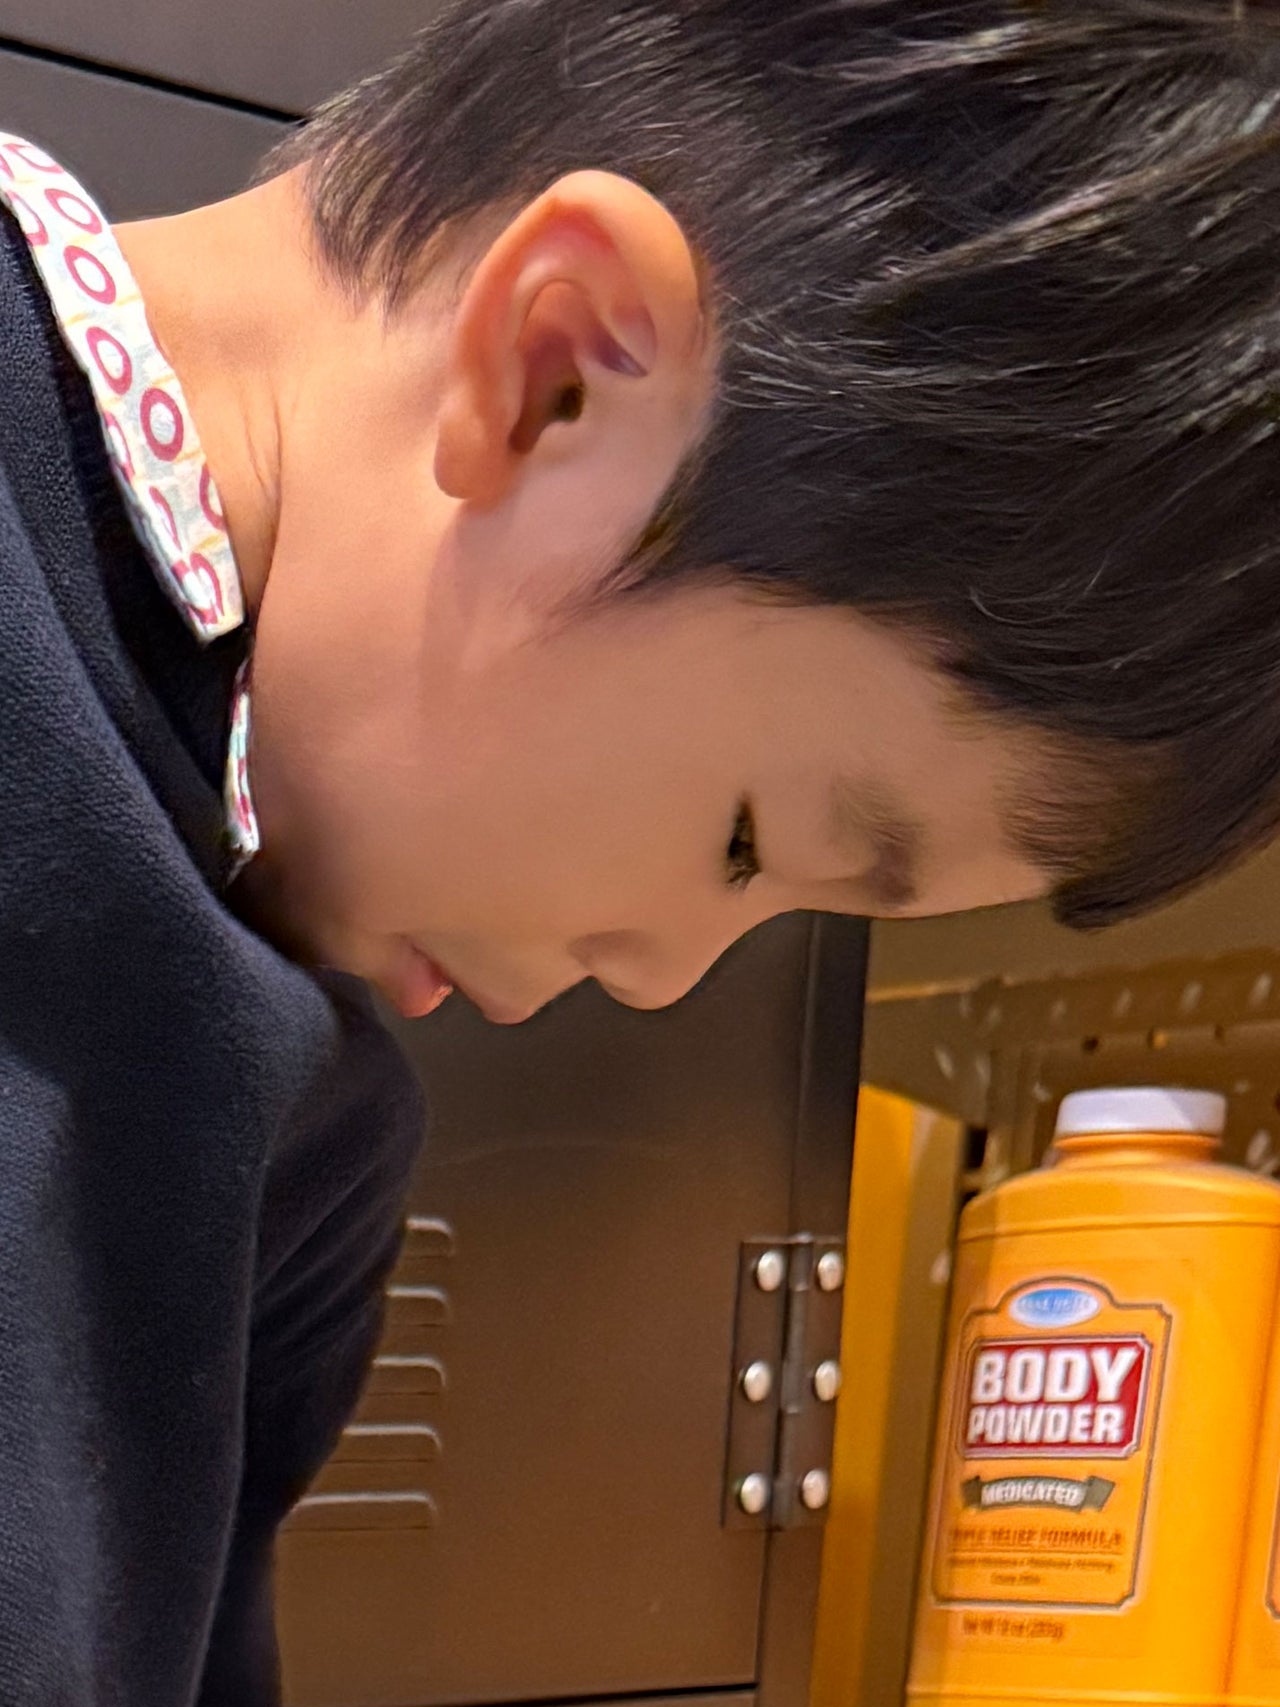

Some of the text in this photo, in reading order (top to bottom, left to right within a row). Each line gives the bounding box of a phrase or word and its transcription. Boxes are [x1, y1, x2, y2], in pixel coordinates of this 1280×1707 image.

[971, 1346, 1140, 1404] BODY
[967, 1403, 1125, 1445] POWDER
[981, 1479, 1084, 1508] MEDICATED
